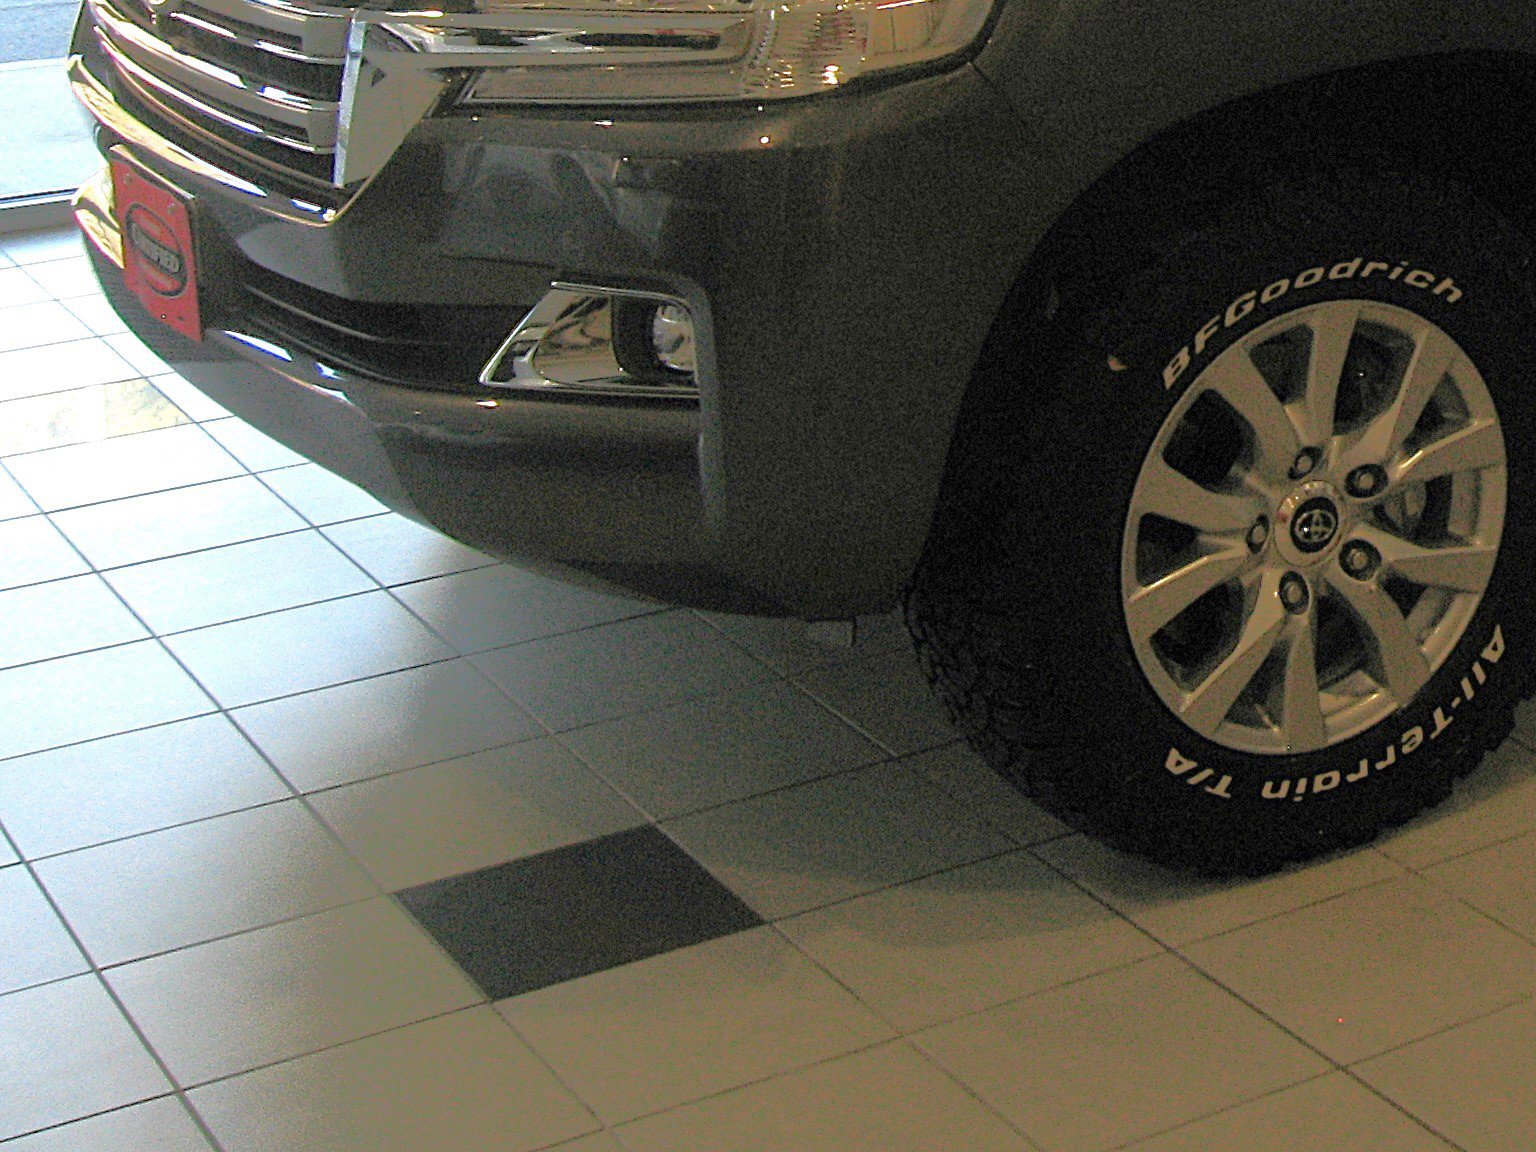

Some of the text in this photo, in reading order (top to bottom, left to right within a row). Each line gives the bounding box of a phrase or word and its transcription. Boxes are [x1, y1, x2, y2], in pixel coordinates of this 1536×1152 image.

[1163, 257, 1463, 390] BFGoodrich
[1164, 624, 1506, 802] All-Terrain T/A
